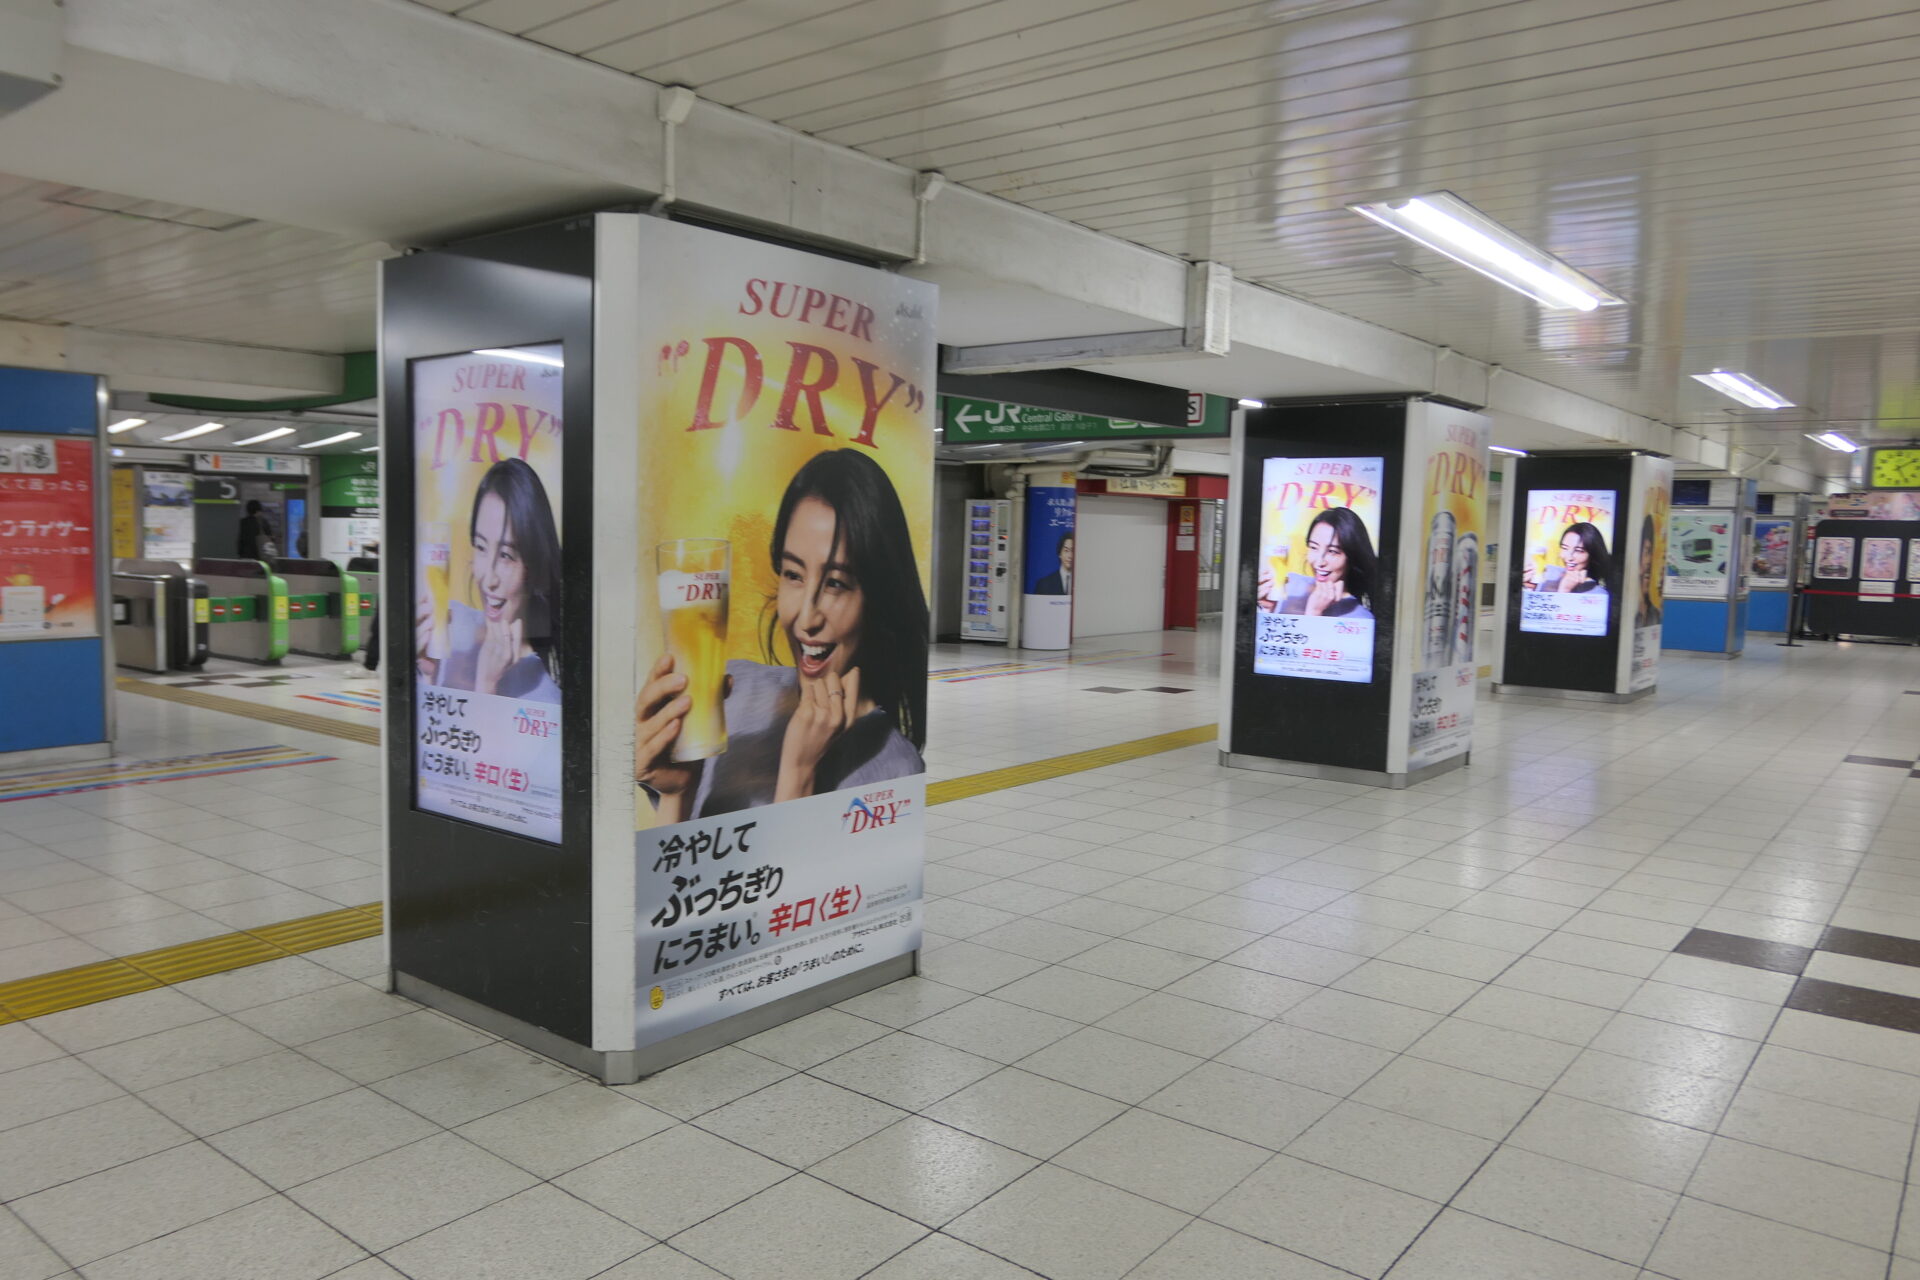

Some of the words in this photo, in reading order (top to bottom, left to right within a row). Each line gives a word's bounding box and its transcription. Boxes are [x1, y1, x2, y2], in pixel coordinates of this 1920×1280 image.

[739, 278, 875, 343] SUPER
[453, 364, 526, 392] SUPER
[984, 402, 1021, 424] JR
[1021, 414, 1052, 423] Central
[1054, 412, 1075, 422] Gate
[1446, 424, 1476, 448] SUPER
[1295, 462, 1352, 477] SUPER
[1552, 493, 1594, 503] SUPER
[422, 691, 468, 717] 冷やして
[421, 716, 482, 753] ぶっちぎり
[422, 751, 471, 780] にうまい。
[863, 789, 894, 804] SUPER
[652, 821, 757, 873] 冷やして
[650, 863, 784, 928] ぶっちぎり
[653, 918, 760, 975] にうまい。
